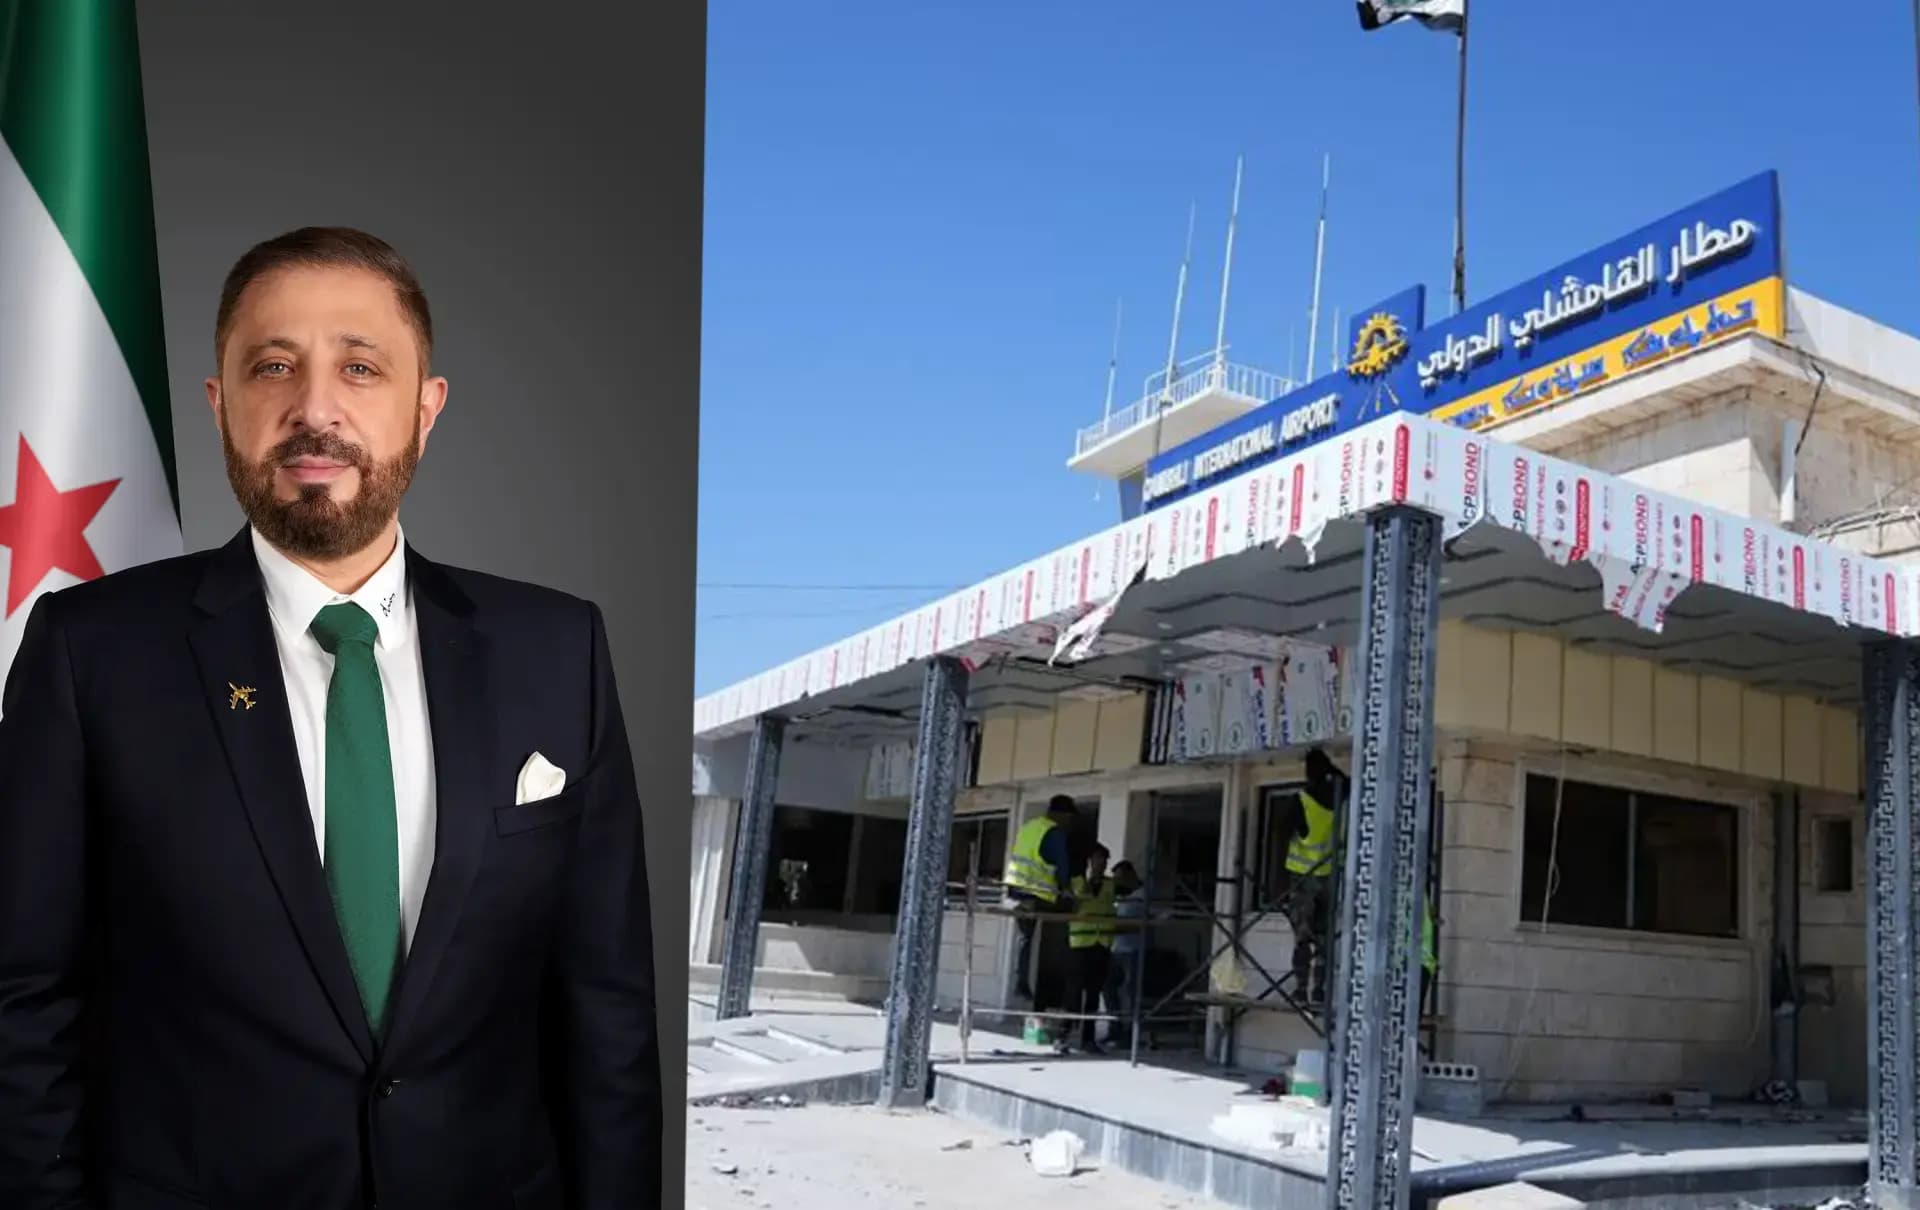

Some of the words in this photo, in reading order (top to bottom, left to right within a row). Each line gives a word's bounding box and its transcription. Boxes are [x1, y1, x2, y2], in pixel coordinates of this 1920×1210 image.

[1666, 217, 1756, 284] مطار
[1509, 243, 1654, 347] القامشلي
[1417, 313, 1498, 387] الدولي
[1193, 422, 1276, 480] INTERNATIONAL
[1279, 394, 1339, 441] AIRPORT
[1457, 442, 1479, 529] ACPBOND
[1630, 494, 1649, 574] ACPBOND
